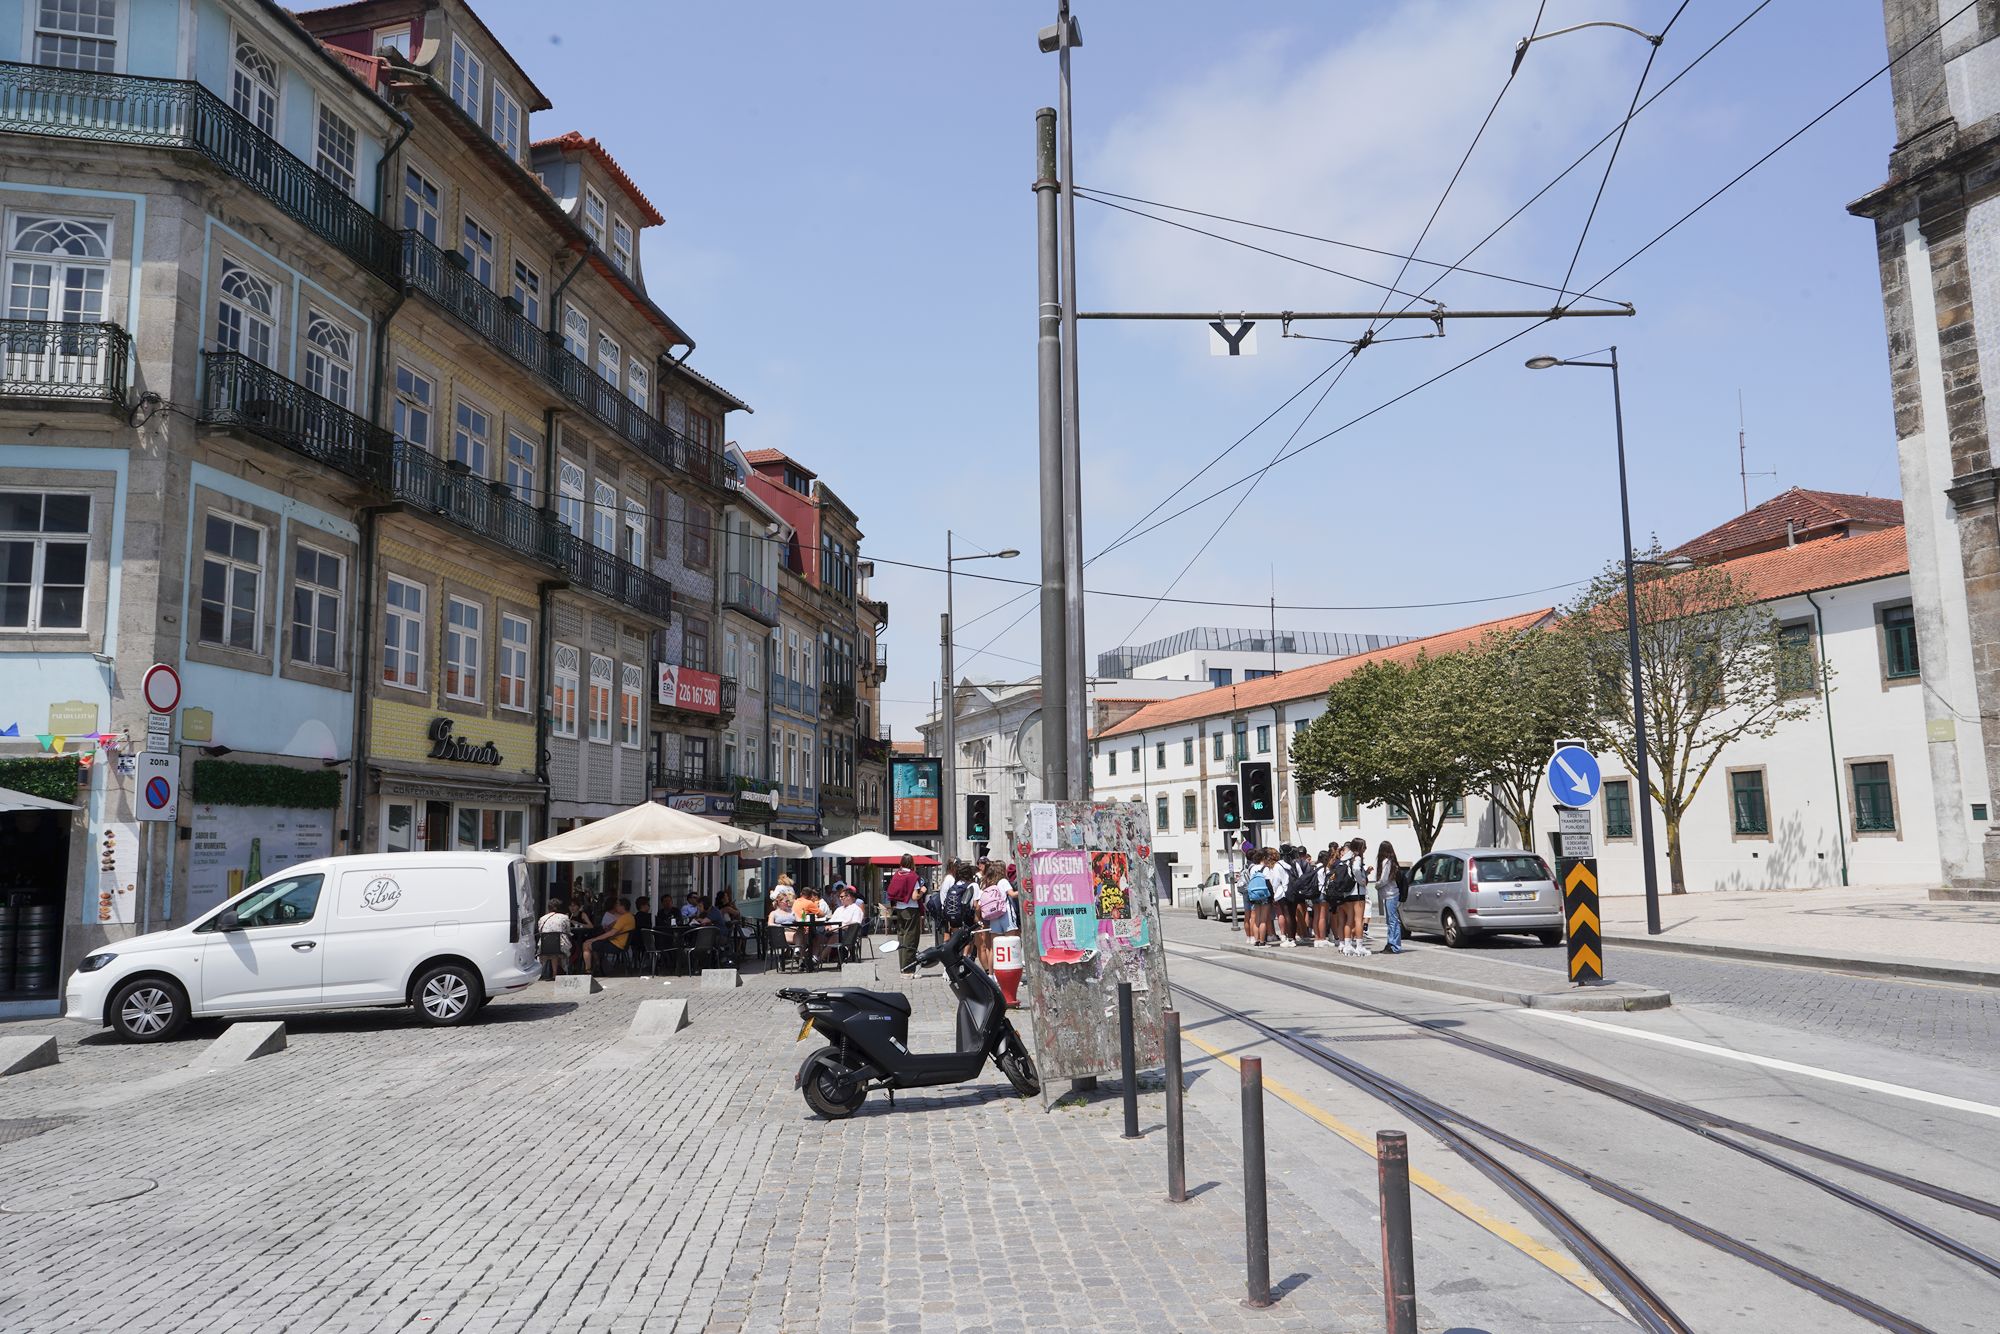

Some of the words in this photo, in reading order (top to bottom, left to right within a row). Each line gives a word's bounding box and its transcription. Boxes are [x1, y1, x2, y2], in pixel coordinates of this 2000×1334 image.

[1208, 321, 1256, 356] Y
[680, 683, 690, 702] 226
[692, 686, 703, 704] 167
[704, 688, 717, 707] 590
[150, 758, 169, 767] zona
[1033, 856, 1084, 876] MUSEUM
[360, 881, 402, 908] Silvas
[1035, 884, 1050, 903] OF
[1053, 883, 1074, 902] SEX
